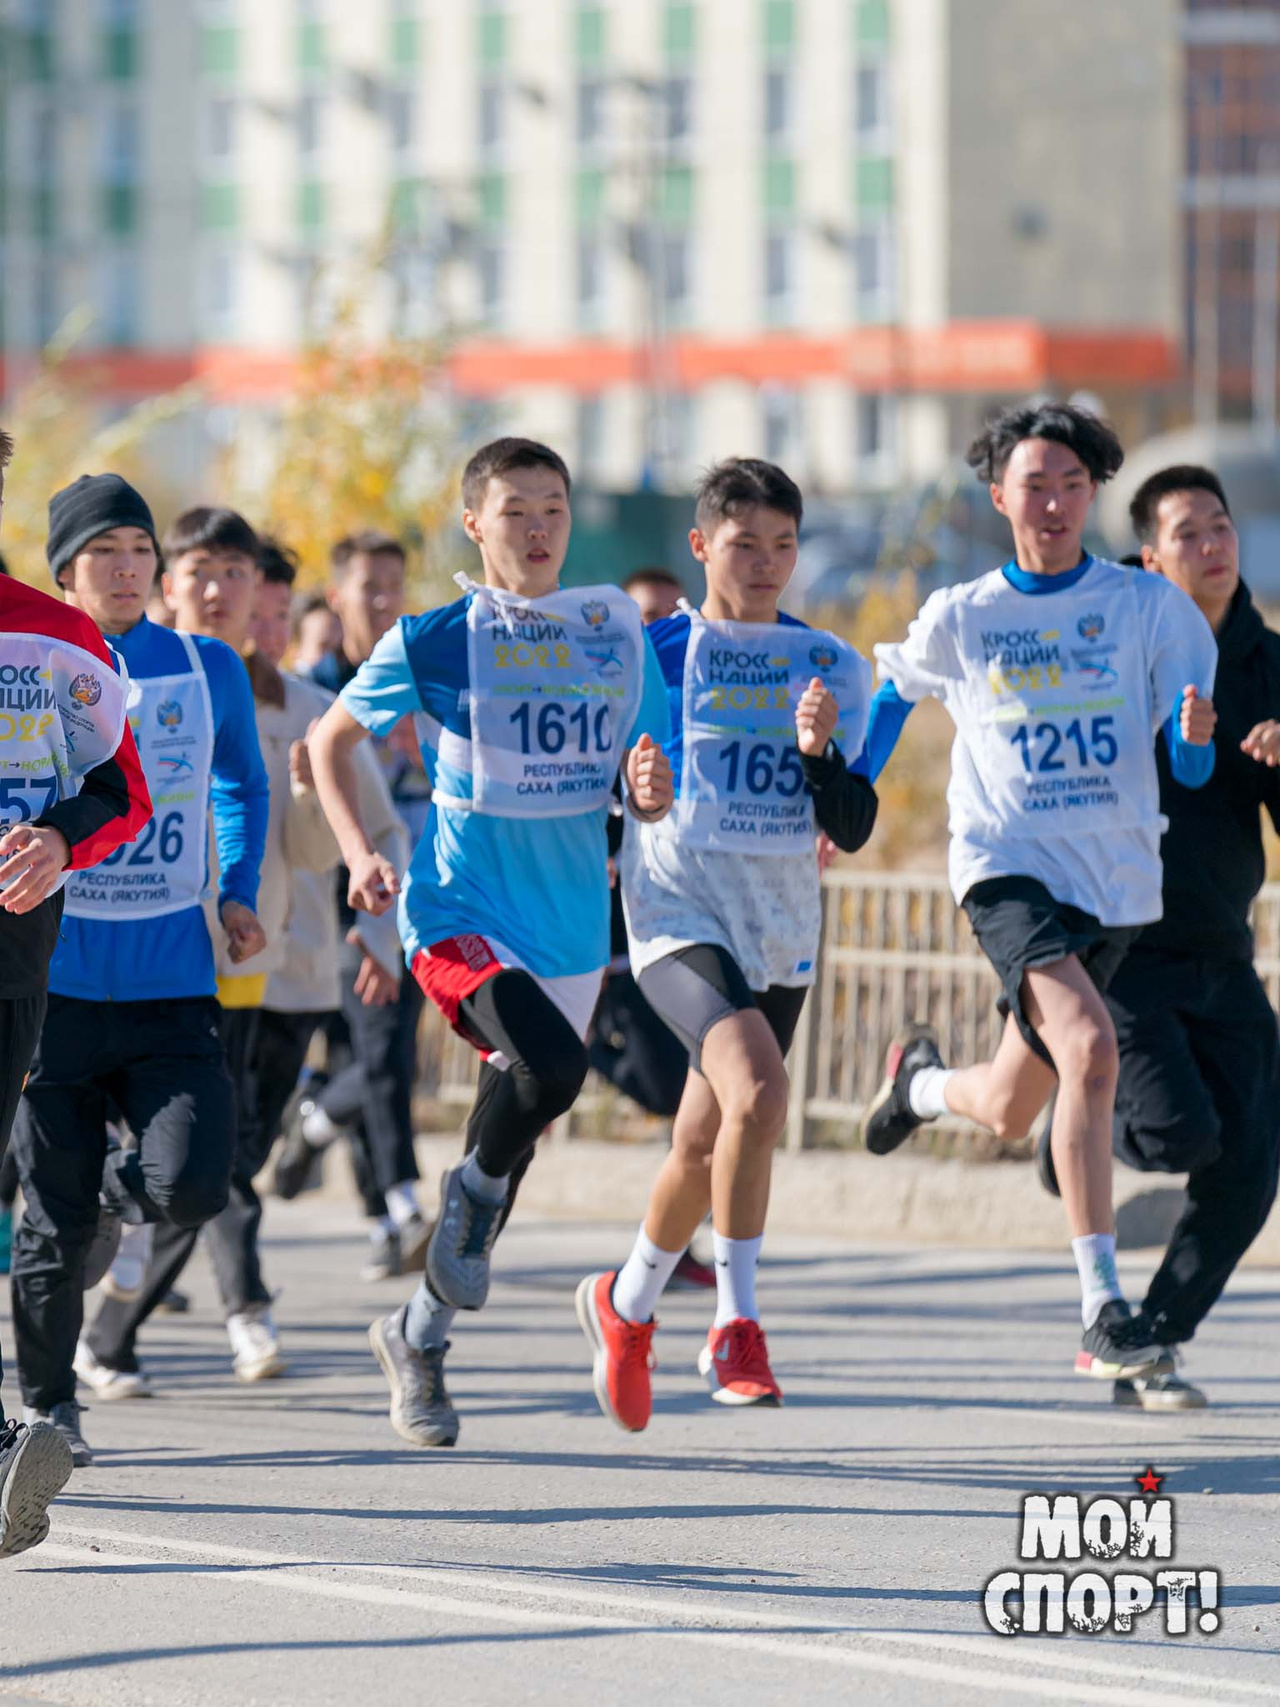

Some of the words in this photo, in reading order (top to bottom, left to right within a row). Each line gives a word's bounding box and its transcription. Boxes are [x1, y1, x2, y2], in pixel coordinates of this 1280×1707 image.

[981, 629, 1040, 650] КРОСС
[494, 643, 572, 668] 2022
[709, 649, 769, 670] КРОСС
[709, 667, 789, 685] НАЦИИ
[710, 686, 790, 711] 2022
[509, 701, 613, 754] 1610
[1010, 716, 1118, 773] 1215
[523, 762, 602, 778] РЕСПУБЛИК
[718, 740, 813, 798] 165
[517, 781, 554, 796] САХА
[557, 778, 607, 797] (ЯКУТИ
[720, 818, 757, 834] САХА
[78, 871, 167, 888] РЕСПУБЛИКА
[69, 885, 107, 902] САХА
